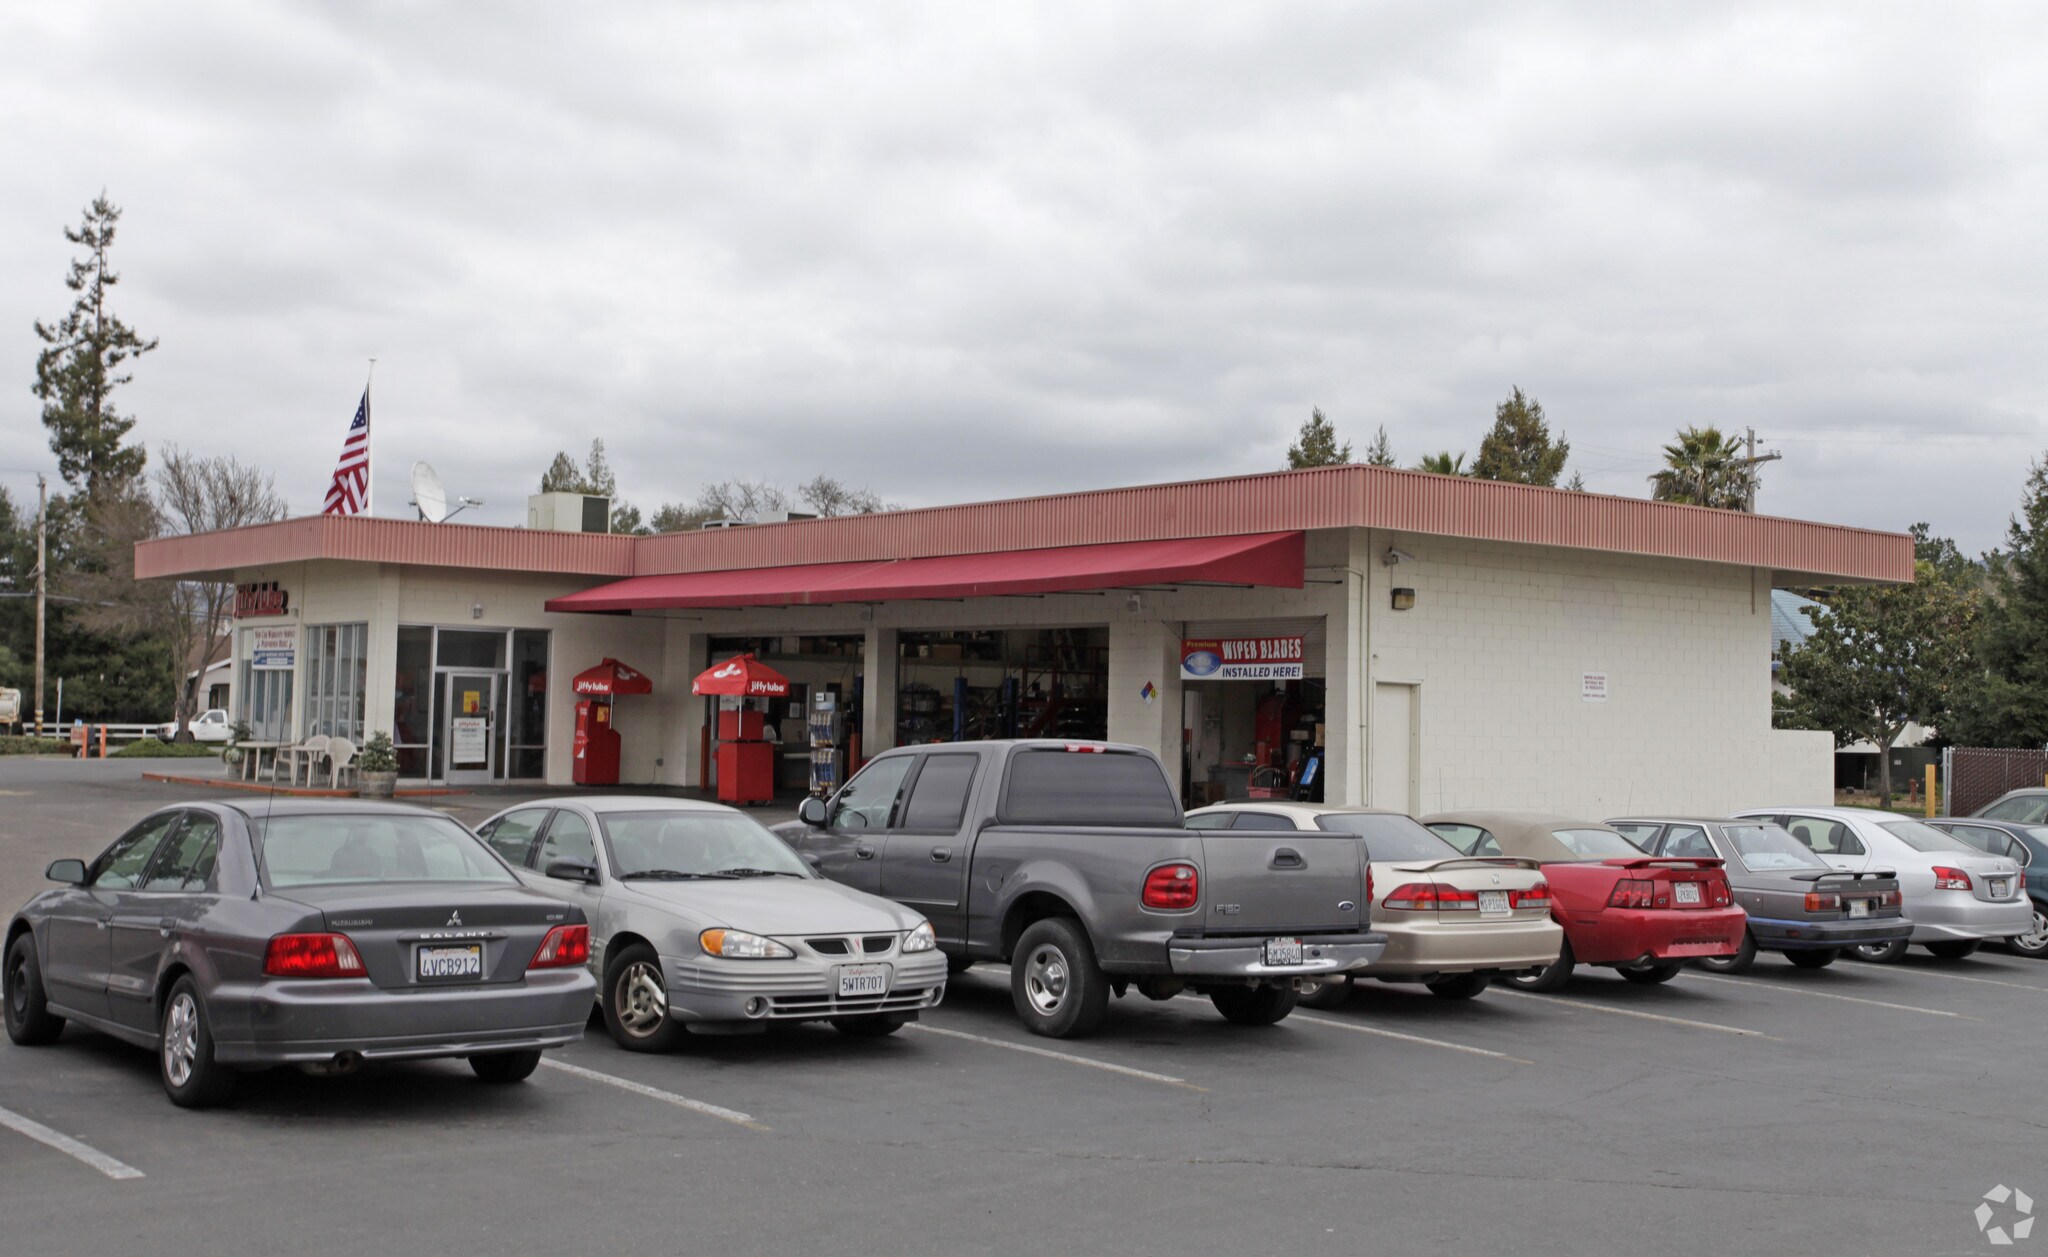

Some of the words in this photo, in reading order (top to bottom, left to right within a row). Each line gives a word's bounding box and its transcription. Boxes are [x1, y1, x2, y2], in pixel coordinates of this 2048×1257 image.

[1222, 640, 1257, 660] WIPER
[1260, 638, 1301, 659] BLADES
[1222, 667, 1270, 678] INSTALLED
[1272, 666, 1300, 677] HERE!
[577, 681, 593, 693] jiffy
[592, 682, 609, 691] lube
[750, 681, 766, 693] jiffy
[766, 682, 785, 692] lube
[422, 957, 478, 976] 4VCB912
[842, 976, 883, 991] 5WTR707
